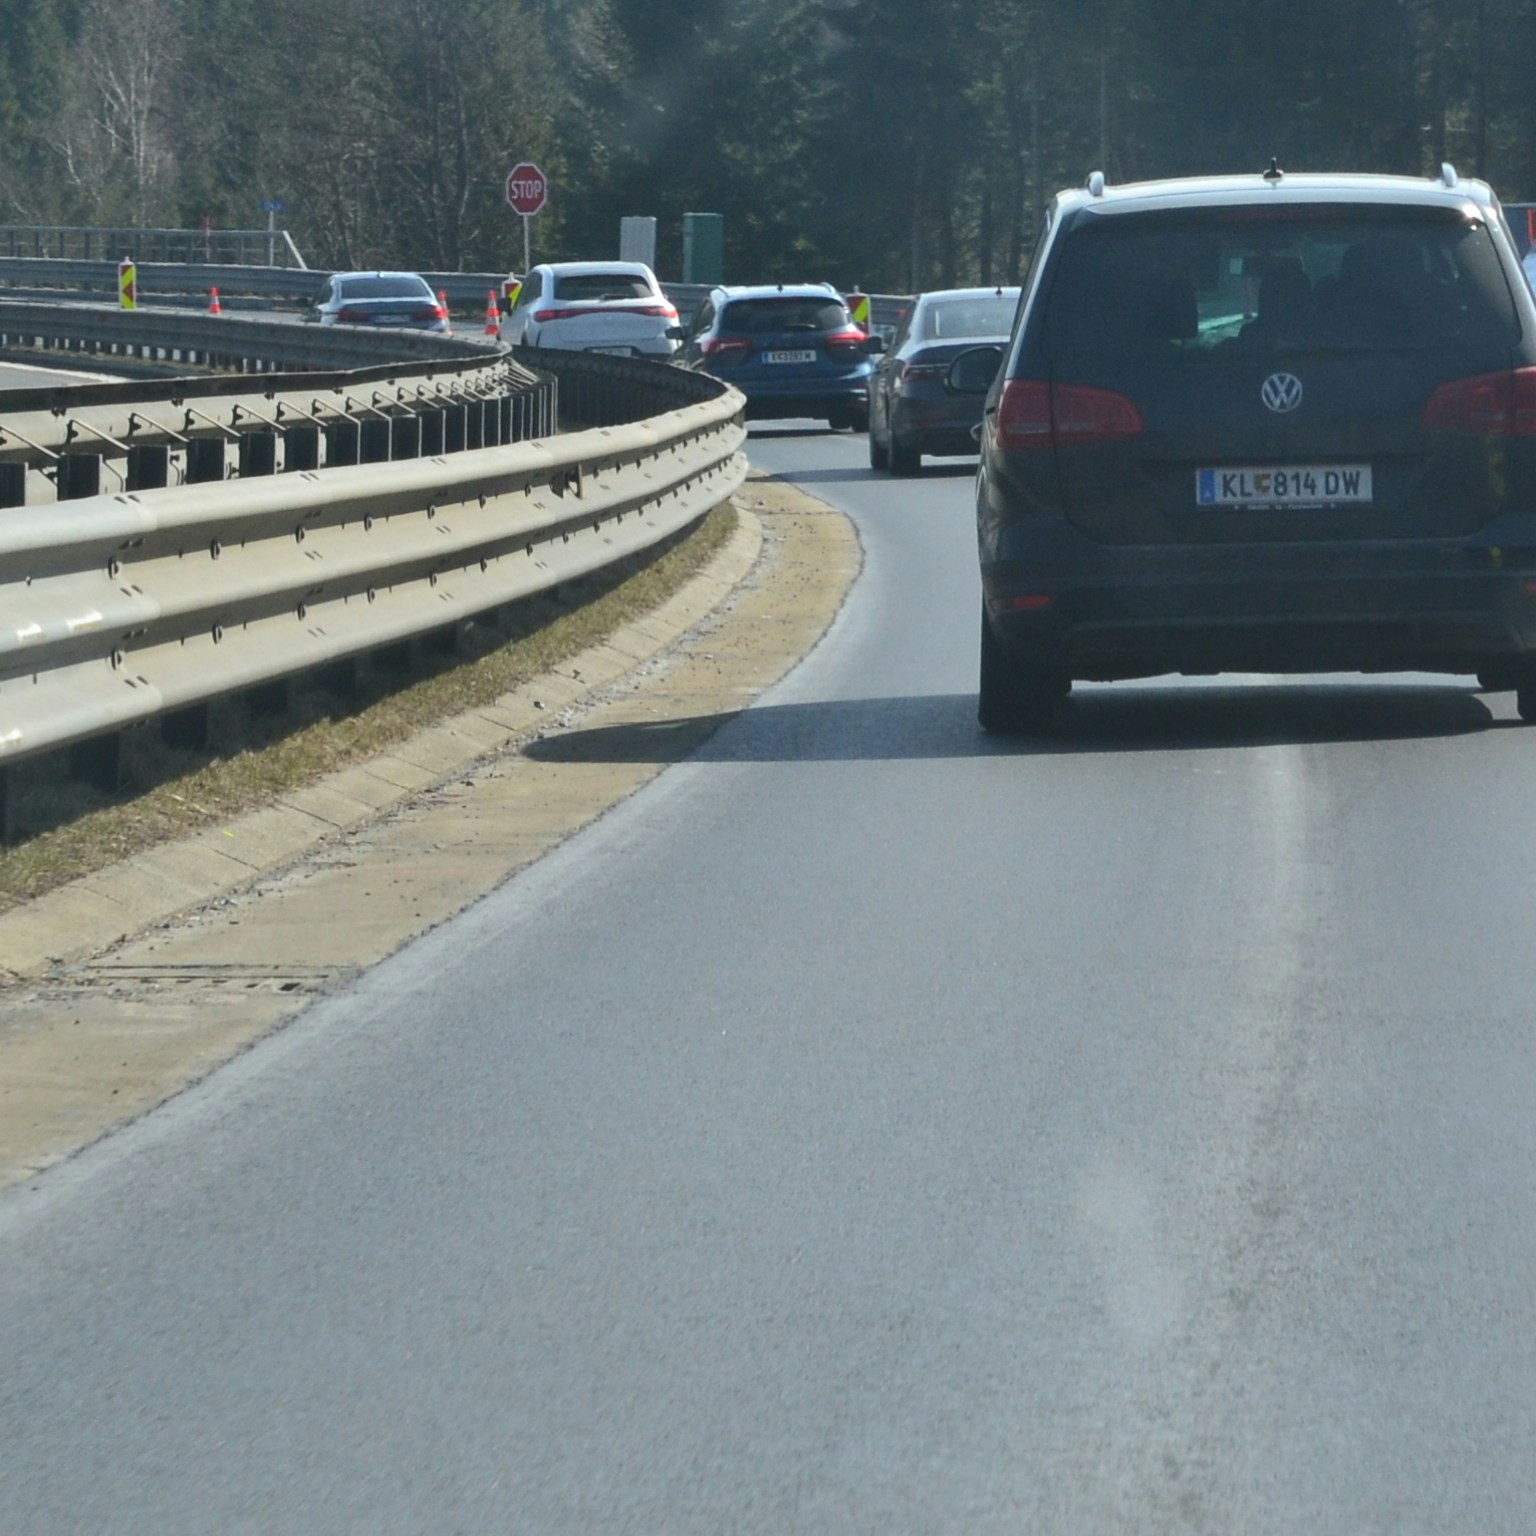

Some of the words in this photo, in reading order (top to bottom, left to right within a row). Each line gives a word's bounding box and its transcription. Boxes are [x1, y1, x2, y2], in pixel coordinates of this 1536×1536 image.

[511, 180, 542, 199] STOP
[1222, 473, 1252, 498] KL
[1273, 471, 1317, 496] 814
[1325, 470, 1361, 496] DW
